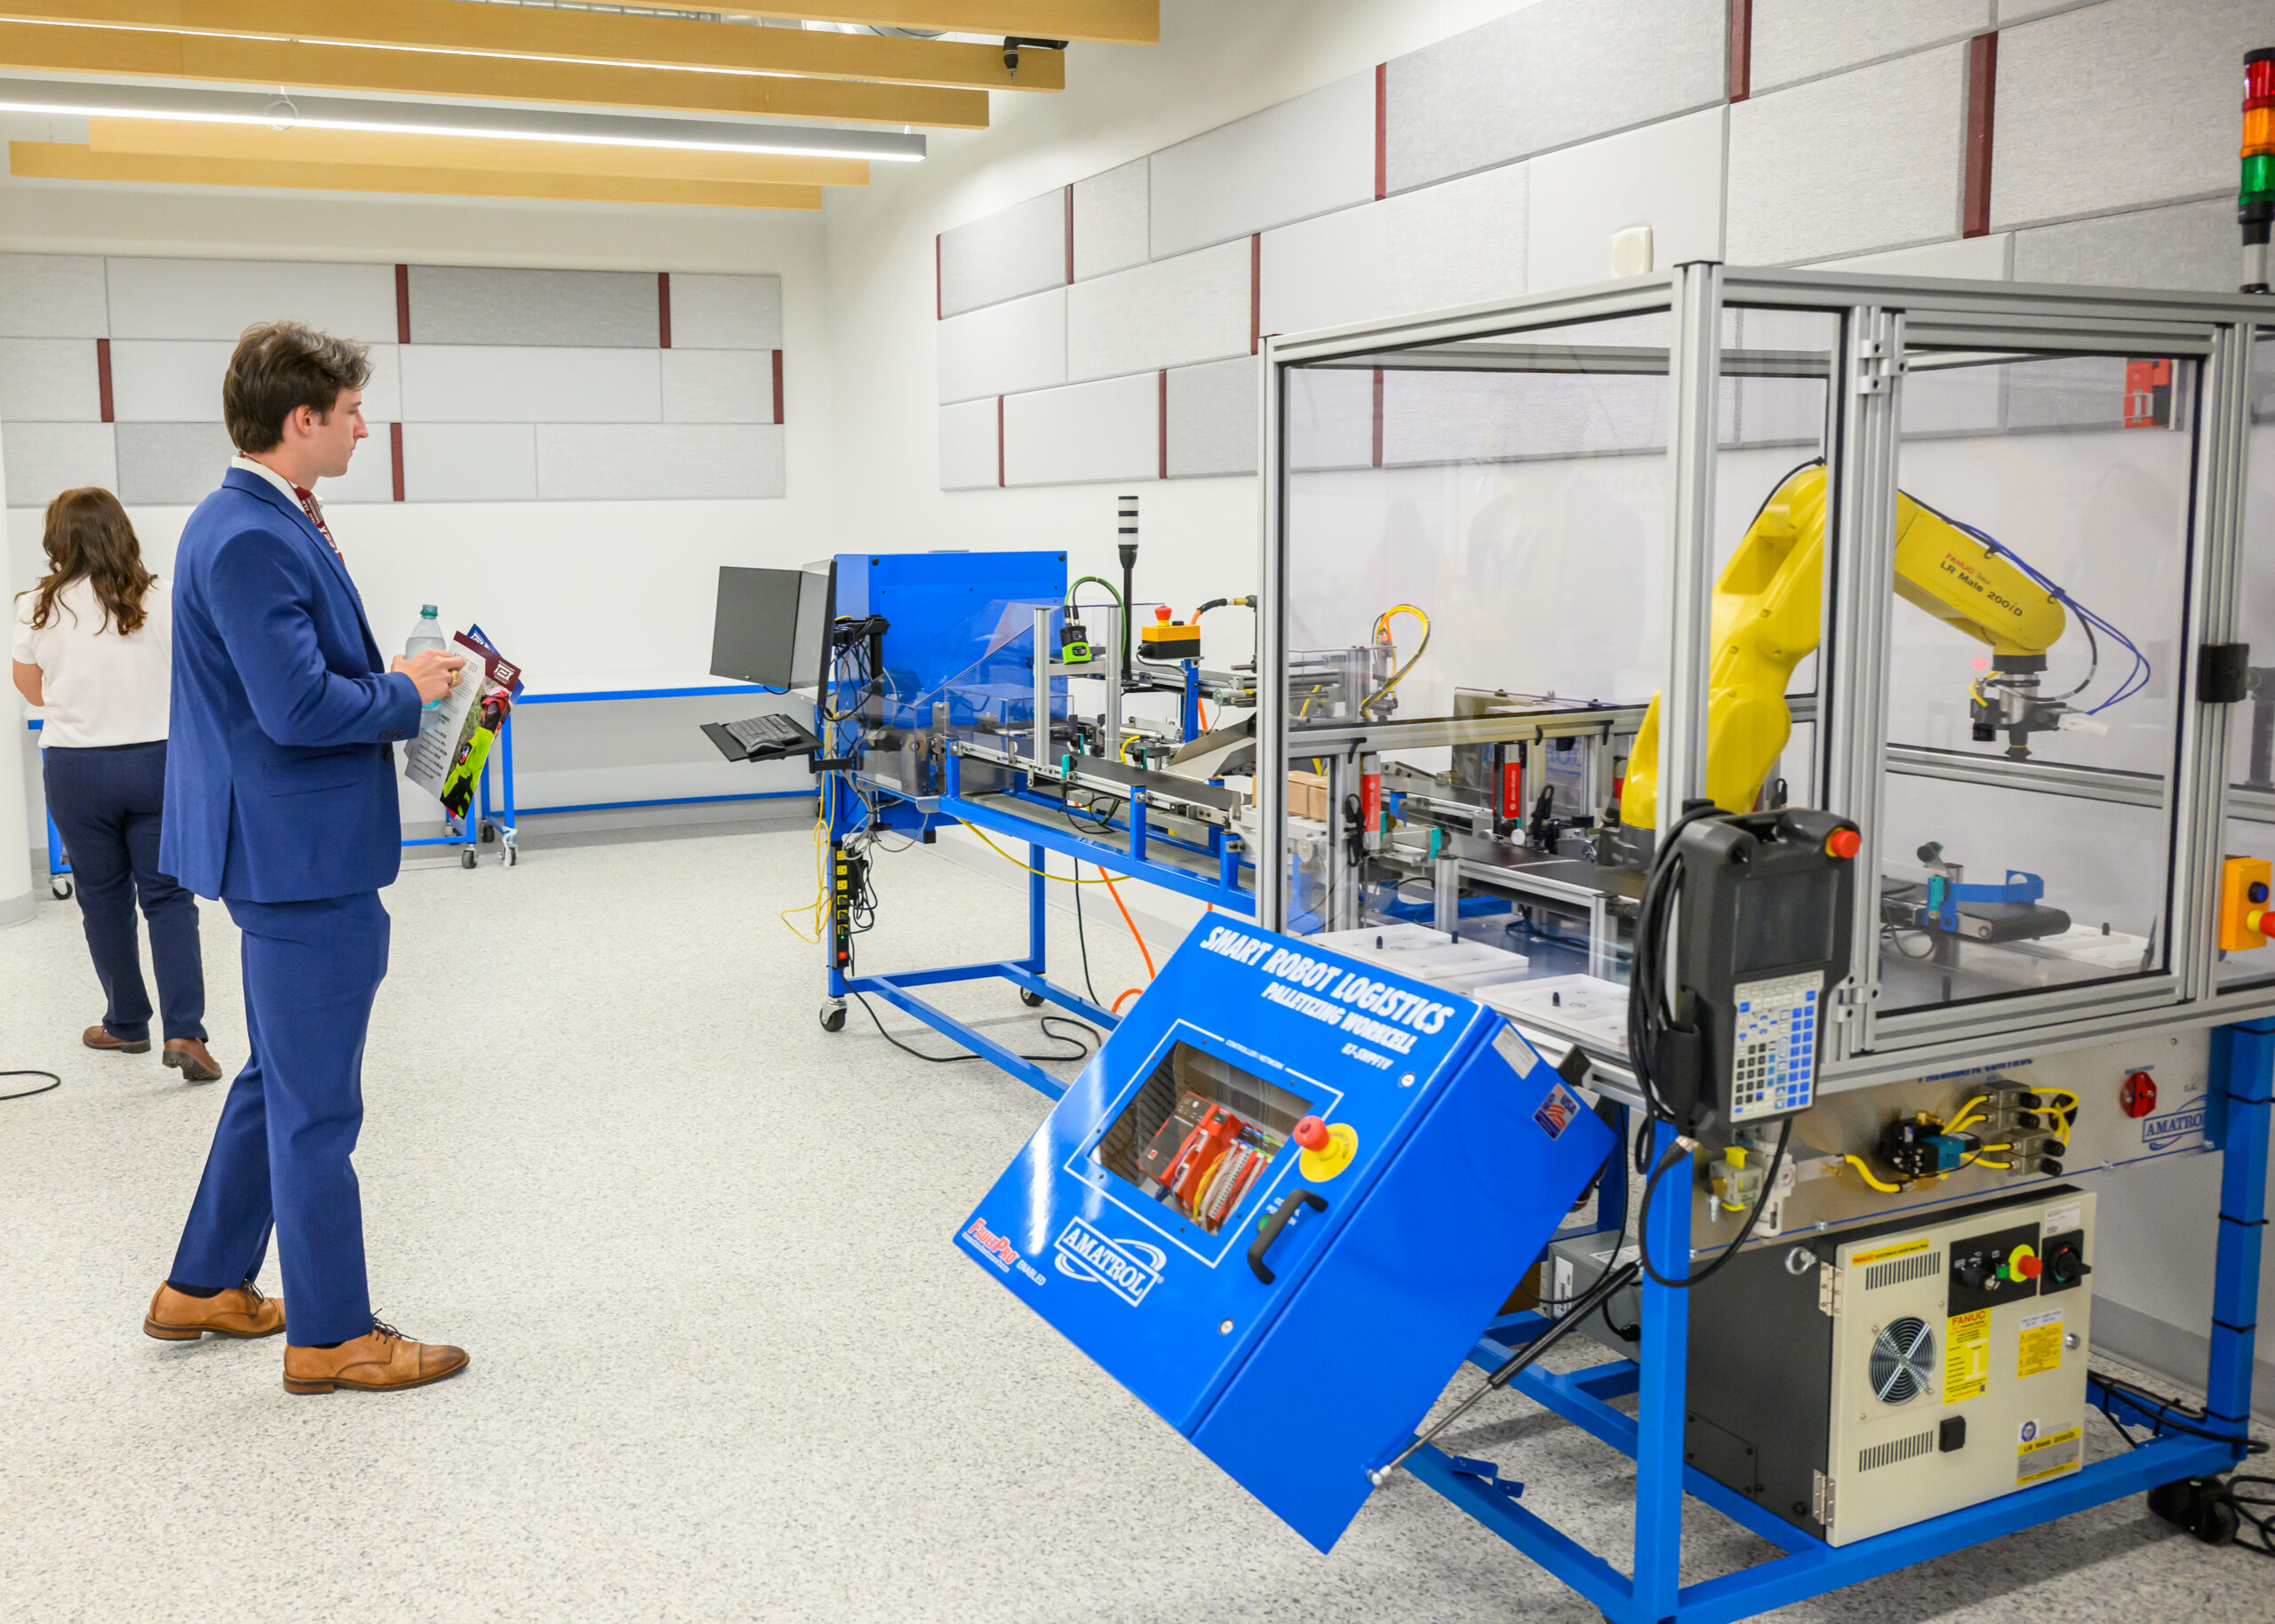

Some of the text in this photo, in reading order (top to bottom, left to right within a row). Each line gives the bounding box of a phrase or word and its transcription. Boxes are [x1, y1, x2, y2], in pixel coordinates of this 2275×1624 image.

[1940, 561, 1957, 574] LR
[1958, 572, 1984, 593] Mate
[1945, 553, 1976, 575] FANUC
[1200, 926, 1456, 1034] SMART ROBOT LOGISTICS
[1261, 982, 1417, 1055] PALLETIZING WORKCELL
[2146, 1113, 2205, 1136] AMATRO
[1016, 1259, 1046, 1286] ENABLED
[1062, 1227, 1146, 1297] AMATROL
[1952, 1310, 1986, 1325] FANUC
